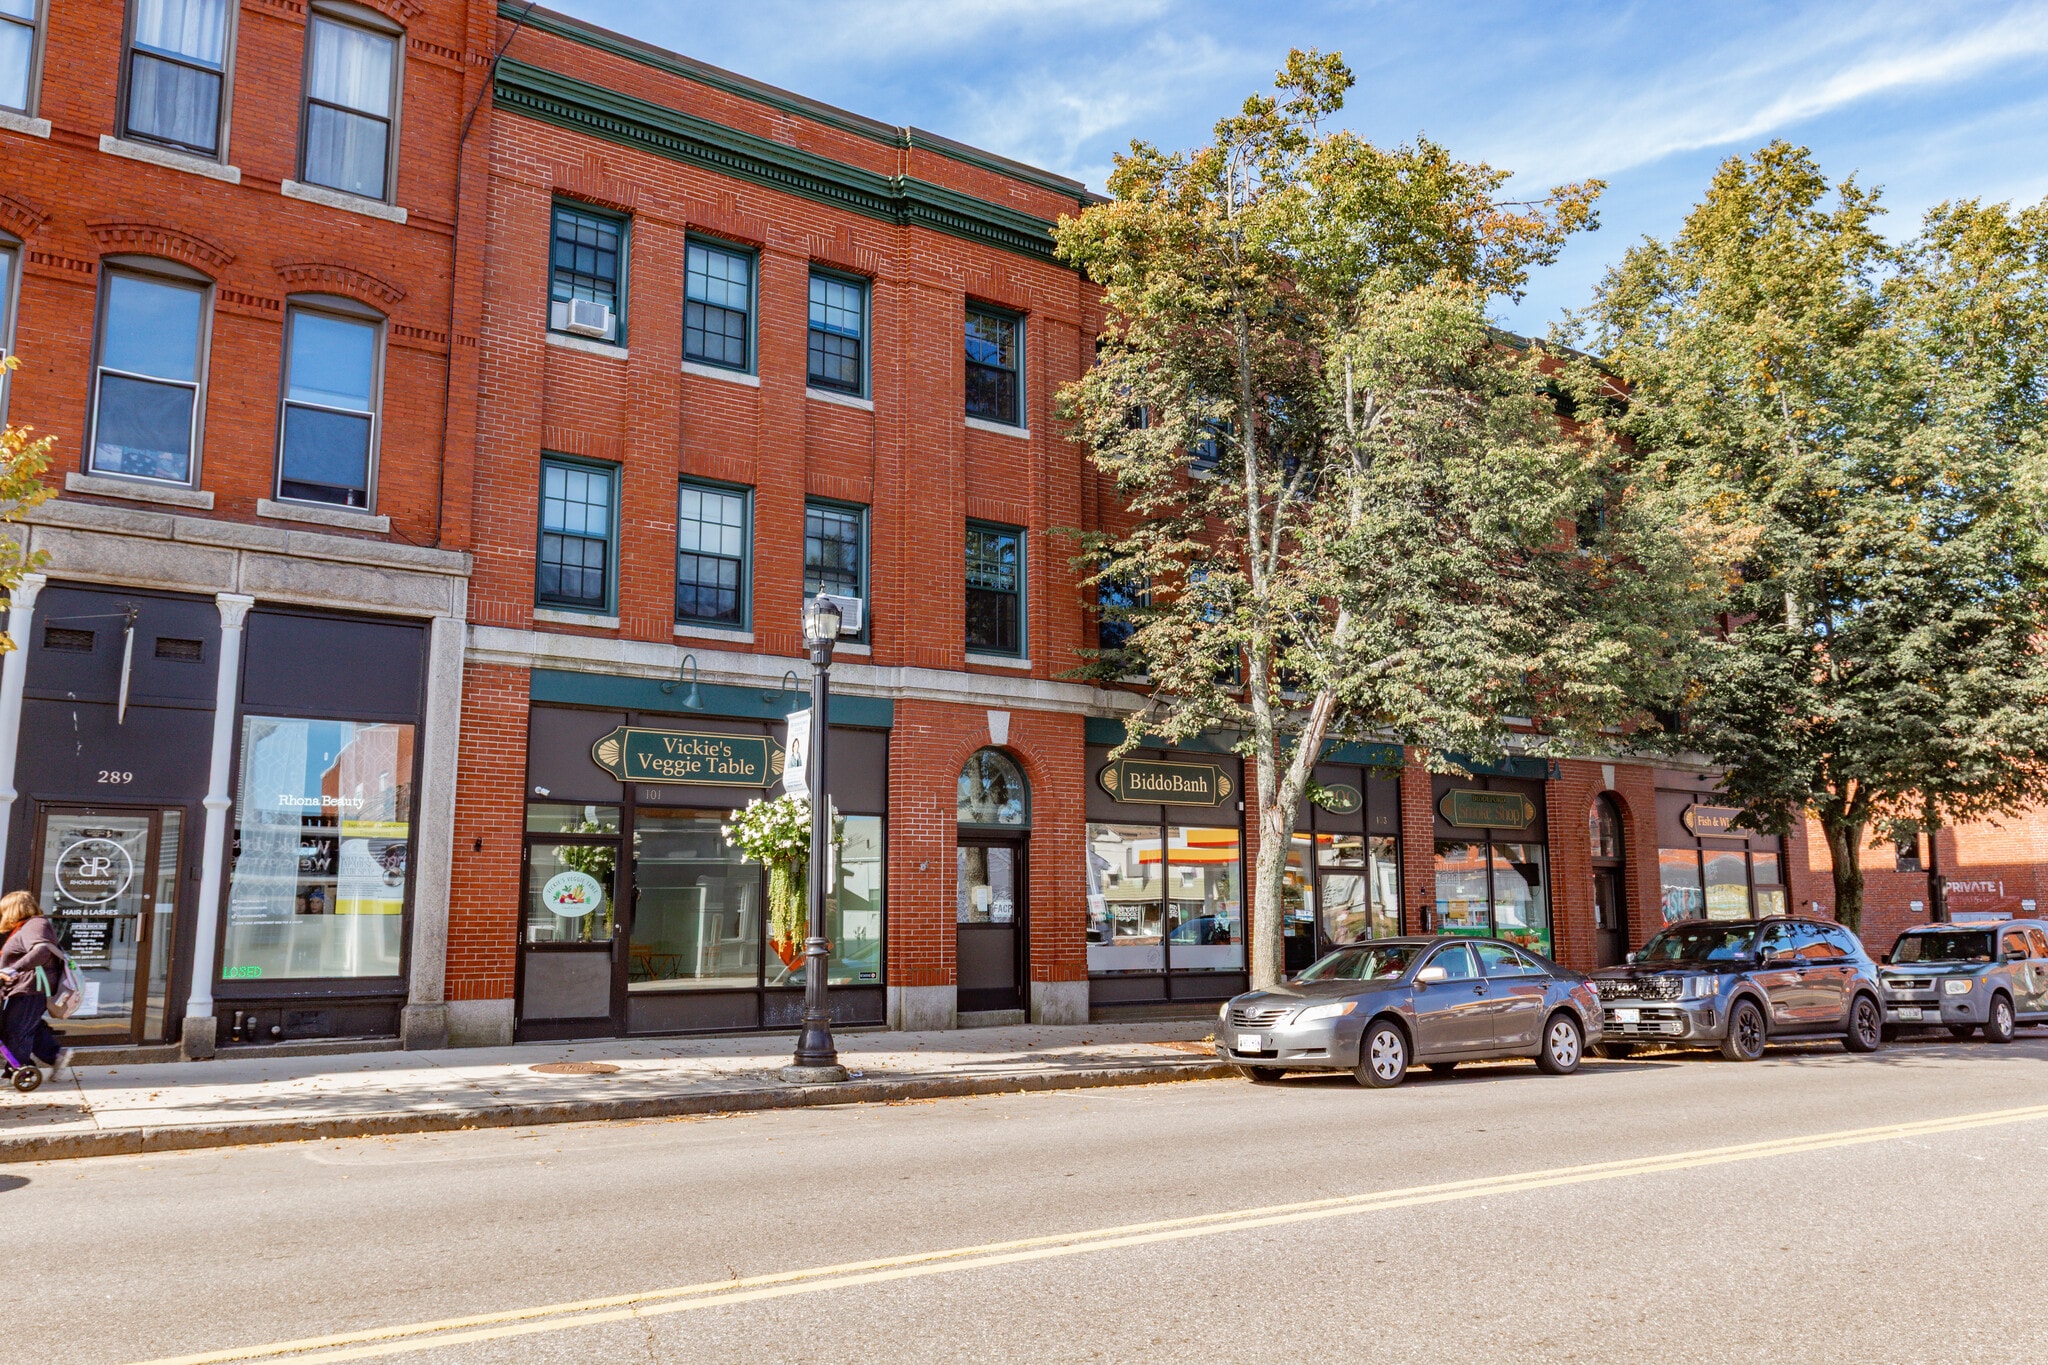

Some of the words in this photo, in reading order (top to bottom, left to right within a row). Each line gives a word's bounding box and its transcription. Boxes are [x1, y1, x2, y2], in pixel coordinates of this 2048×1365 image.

[663, 737, 732, 757] Vickie's
[637, 752, 701, 776] Veggie
[705, 757, 755, 775] Table
[97, 770, 133, 784] 289
[1129, 772, 1208, 793] BiddoBanh
[646, 789, 661, 800] 101
[278, 795, 320, 806] Rhona
[321, 795, 365, 809] Beauty
[1458, 803, 1492, 820] Smoke
[1495, 804, 1520, 825] Shop
[1697, 815, 1712, 826] Fish
[1712, 816, 1719, 827] &
[1945, 881, 1997, 892] PRIVATE
[223, 966, 262, 978] LOSED
